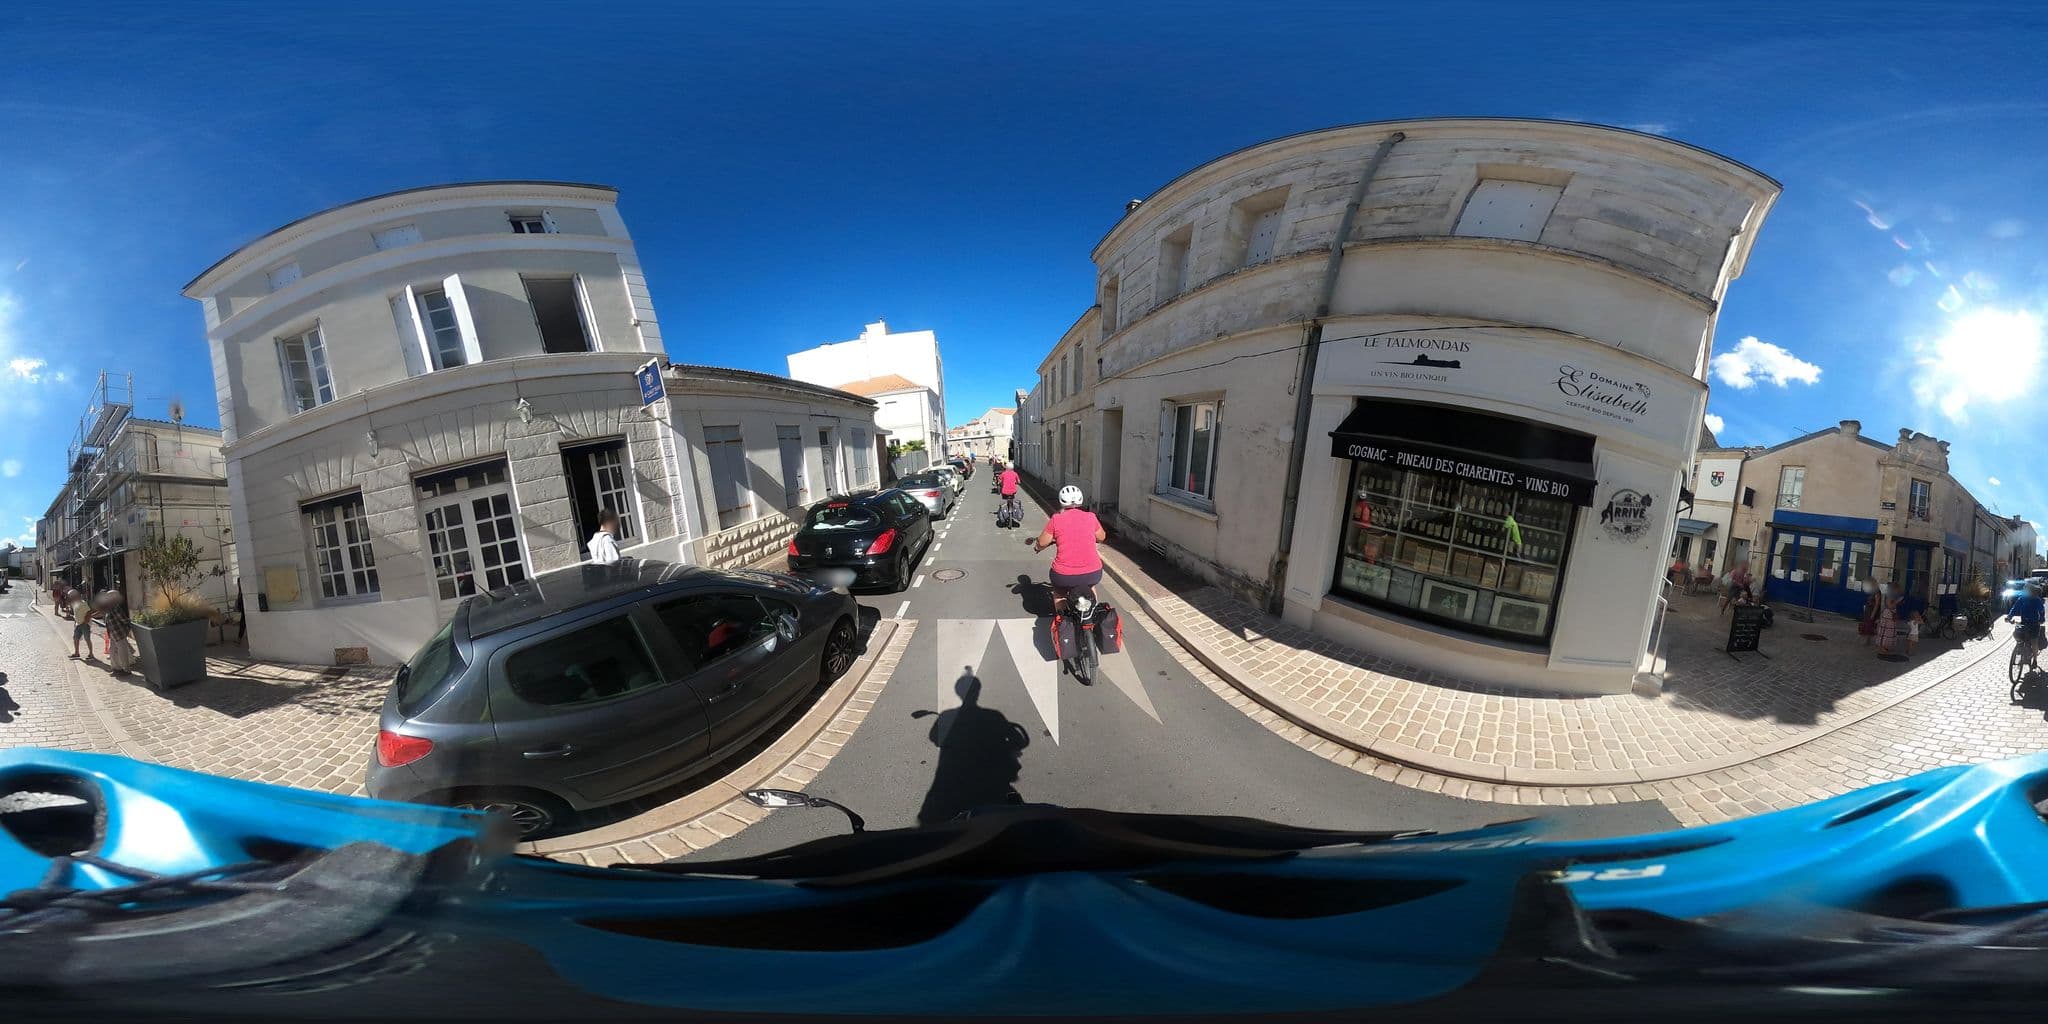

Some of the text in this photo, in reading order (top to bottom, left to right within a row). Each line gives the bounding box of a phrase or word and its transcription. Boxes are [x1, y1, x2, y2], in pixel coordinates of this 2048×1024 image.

[1364, 337, 1471, 353] LE TALMONDAIS
[1416, 373, 1447, 382] UNIQUE
[1552, 365, 1648, 416] Elisabeth
[1348, 444, 1388, 461] COGNAC
[1396, 451, 1434, 470] PINEAU
[1434, 458, 1455, 474] DES
[1455, 462, 1515, 486] CHARENTES
[1525, 476, 1550, 493] VINS
[1551, 481, 1570, 498] BIO
